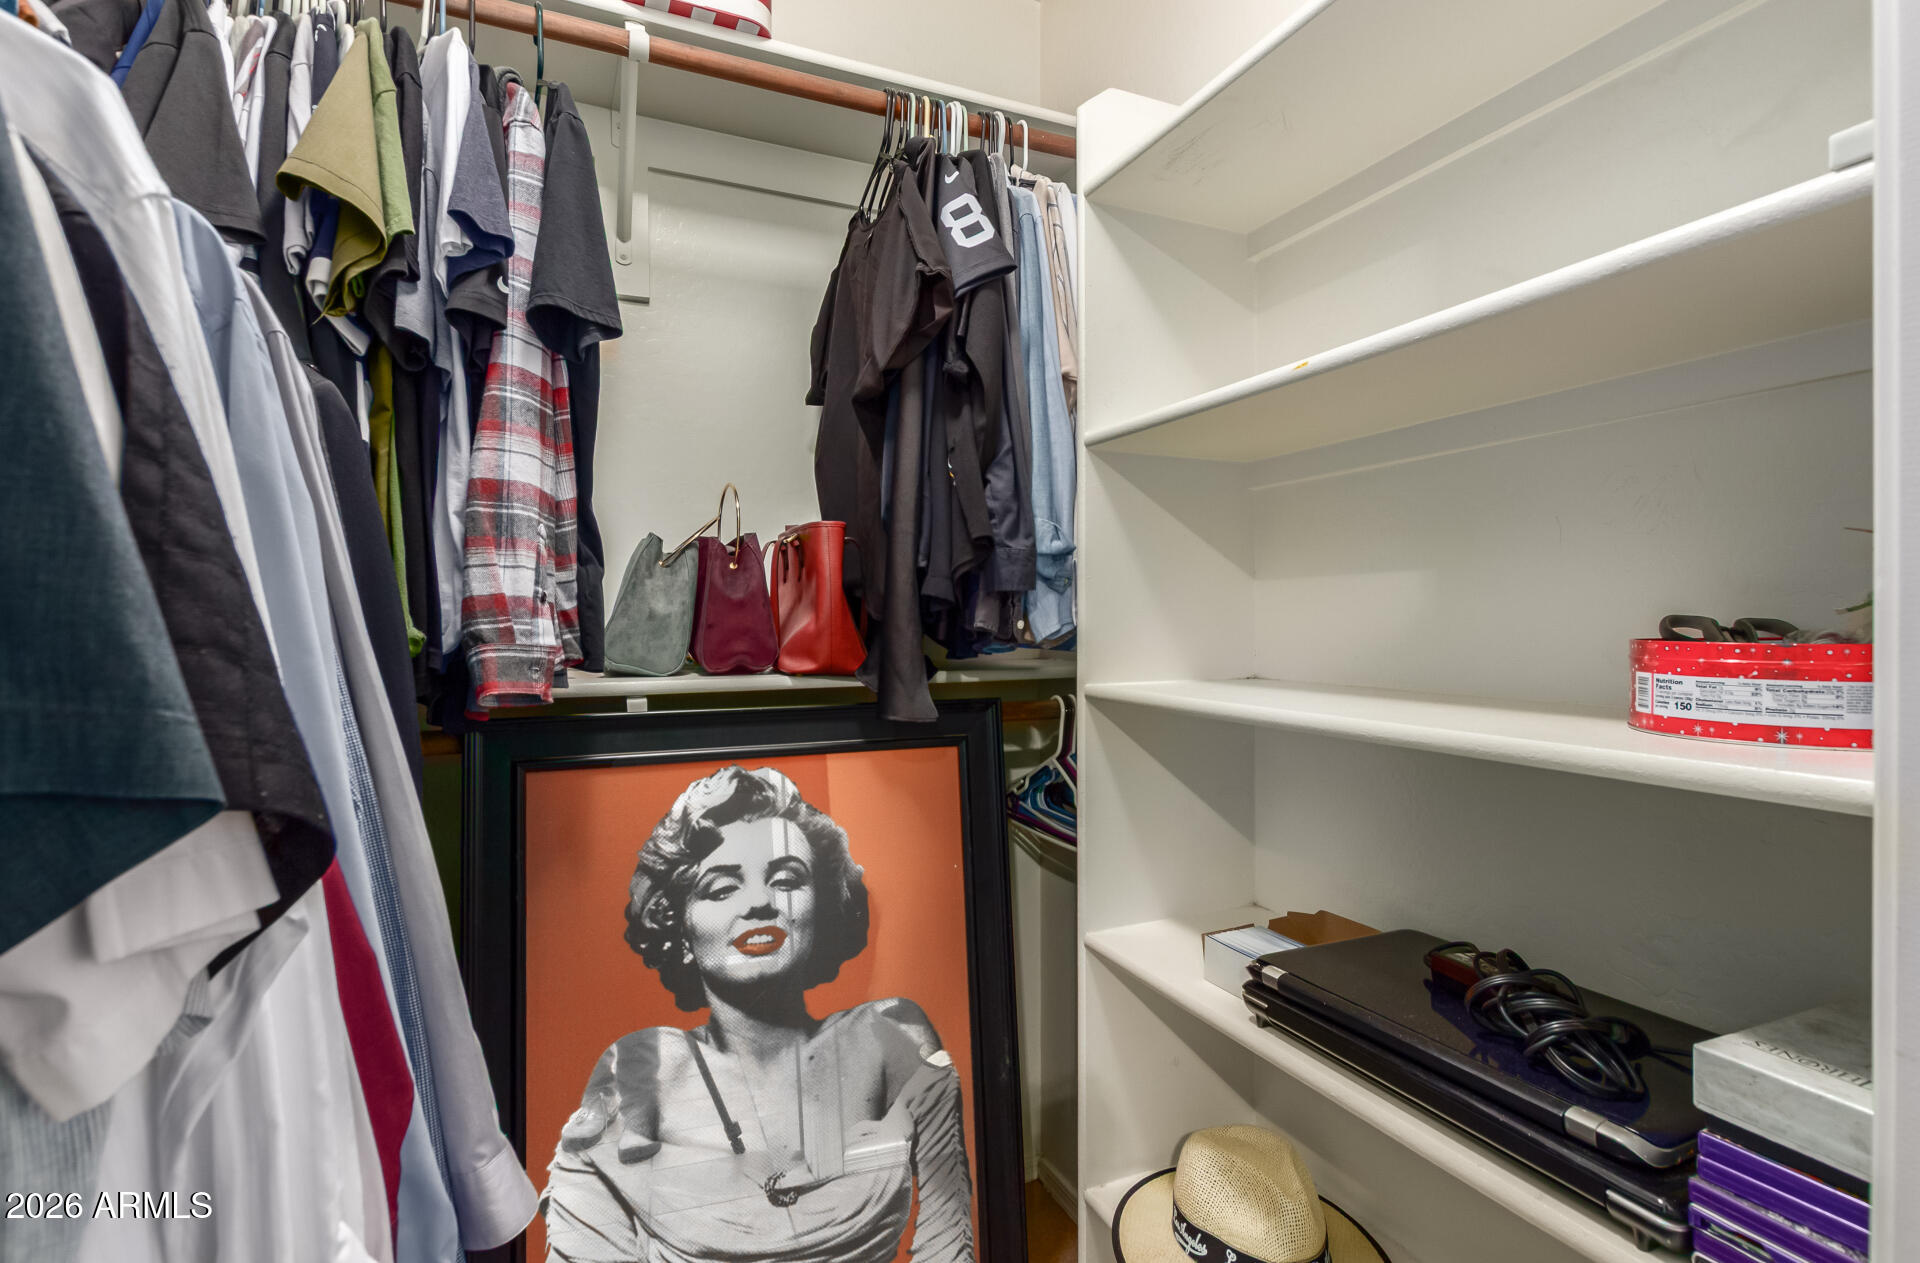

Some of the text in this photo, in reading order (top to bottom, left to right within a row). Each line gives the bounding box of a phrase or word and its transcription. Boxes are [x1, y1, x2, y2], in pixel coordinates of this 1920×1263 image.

[941, 193, 995, 248] 8
[1655, 677, 1683, 685] Nutrition
[1674, 701, 1692, 711] 150
